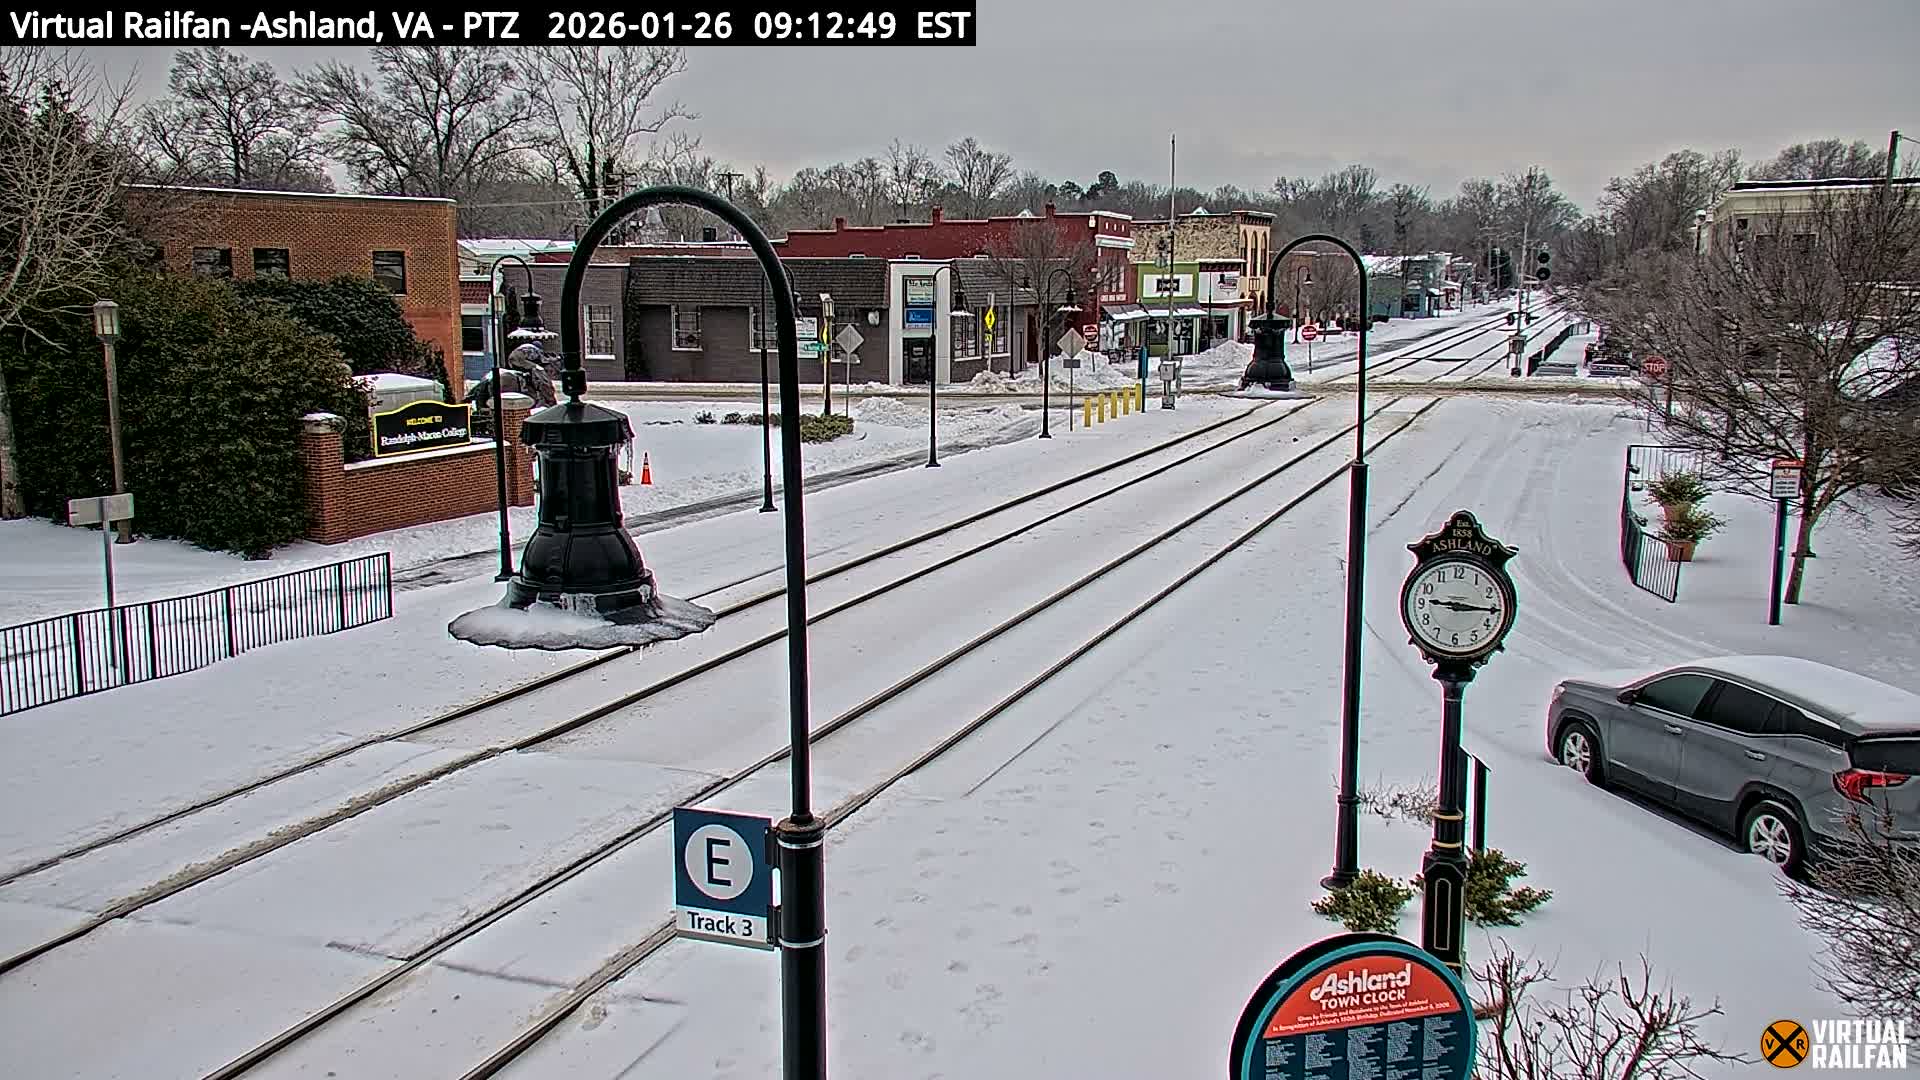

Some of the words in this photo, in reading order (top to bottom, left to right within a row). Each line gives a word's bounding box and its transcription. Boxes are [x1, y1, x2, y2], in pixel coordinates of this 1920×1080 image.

[1645, 362, 1665, 372] STOP
[1452, 529, 1473, 537] 1858
[1433, 539, 1492, 556] ASHLAND
[1437, 570, 1446, 583] 11
[1453, 567, 1465, 580] 12
[1474, 573, 1479, 586] 1
[1422, 583, 1434, 595] 10
[1485, 586, 1493, 599] 2
[1418, 597, 1425, 609] 9
[1422, 613, 1430, 626] 8
[1483, 617, 1491, 630] 4
[1432, 627, 1441, 640] 7
[1451, 633, 1459, 646] 6
[1470, 630, 1478, 643] 5
[706, 837, 733, 887] E
[687, 910, 736, 934] Track
[741, 918, 753, 937] 3
[1310, 963, 1412, 1000] Ashland
[1320, 995, 1360, 1010] TOWN
[1362, 989, 1406, 1004] CLOCK
